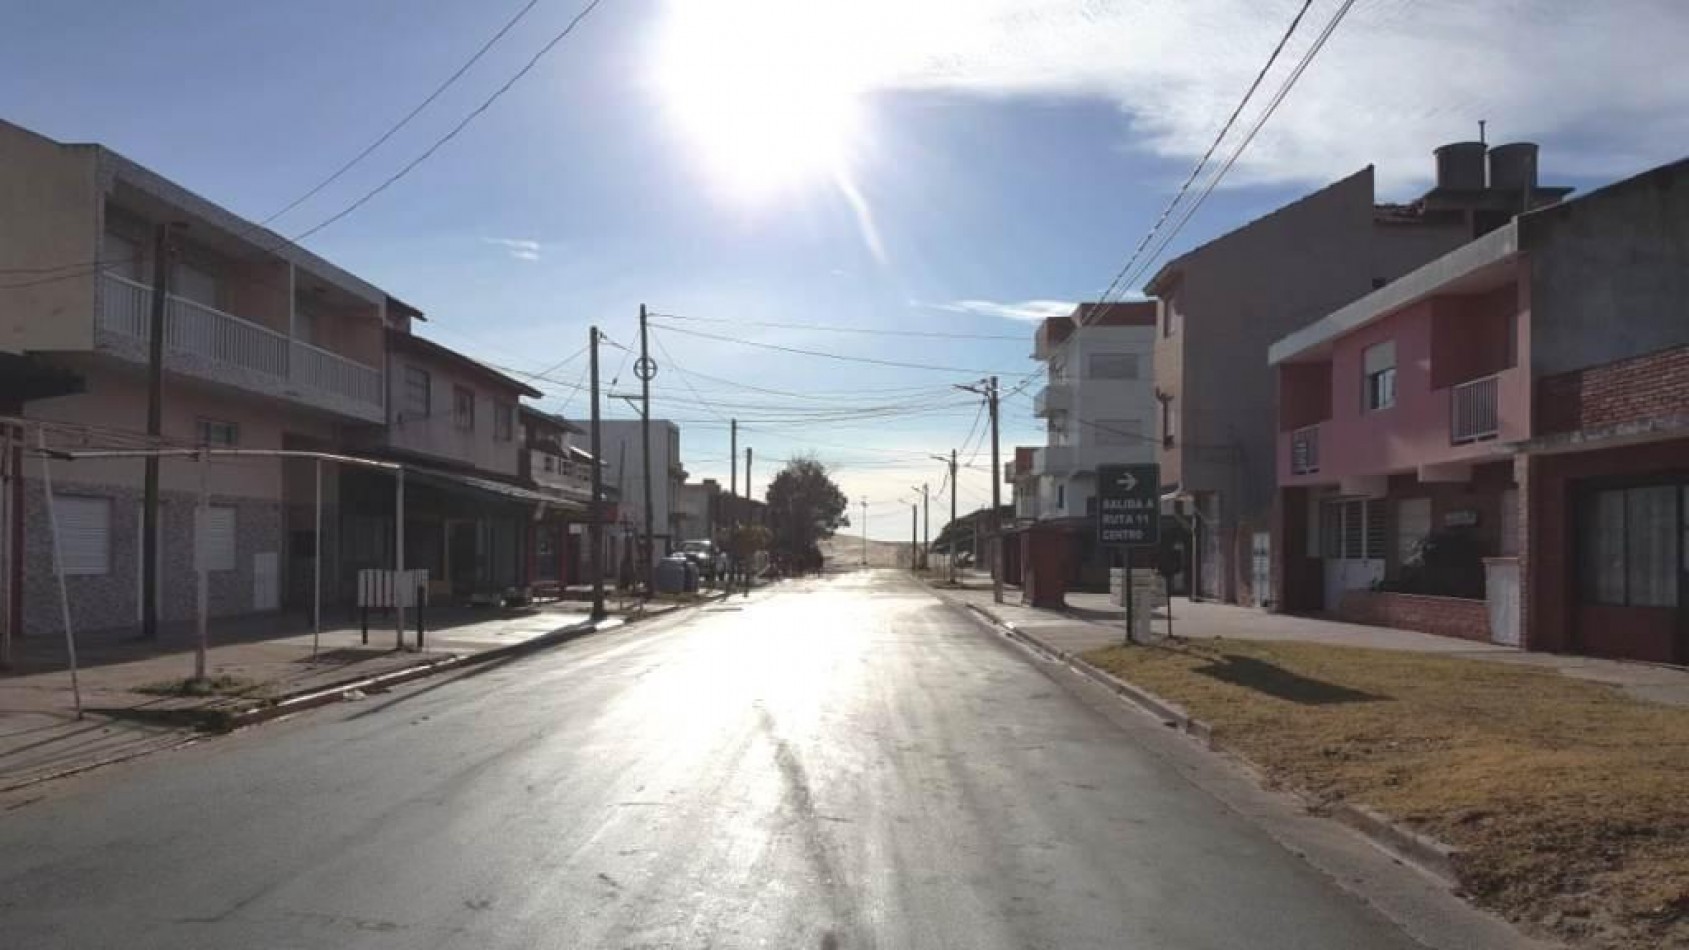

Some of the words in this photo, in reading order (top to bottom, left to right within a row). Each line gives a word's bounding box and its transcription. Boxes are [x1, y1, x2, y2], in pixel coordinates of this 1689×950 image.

[1102, 498, 1143, 509] SALIDA
[1145, 498, 1154, 509] A
[1102, 514, 1134, 525] RUTA
[1136, 514, 1149, 525] 11
[1102, 529, 1144, 540] CENTRO
